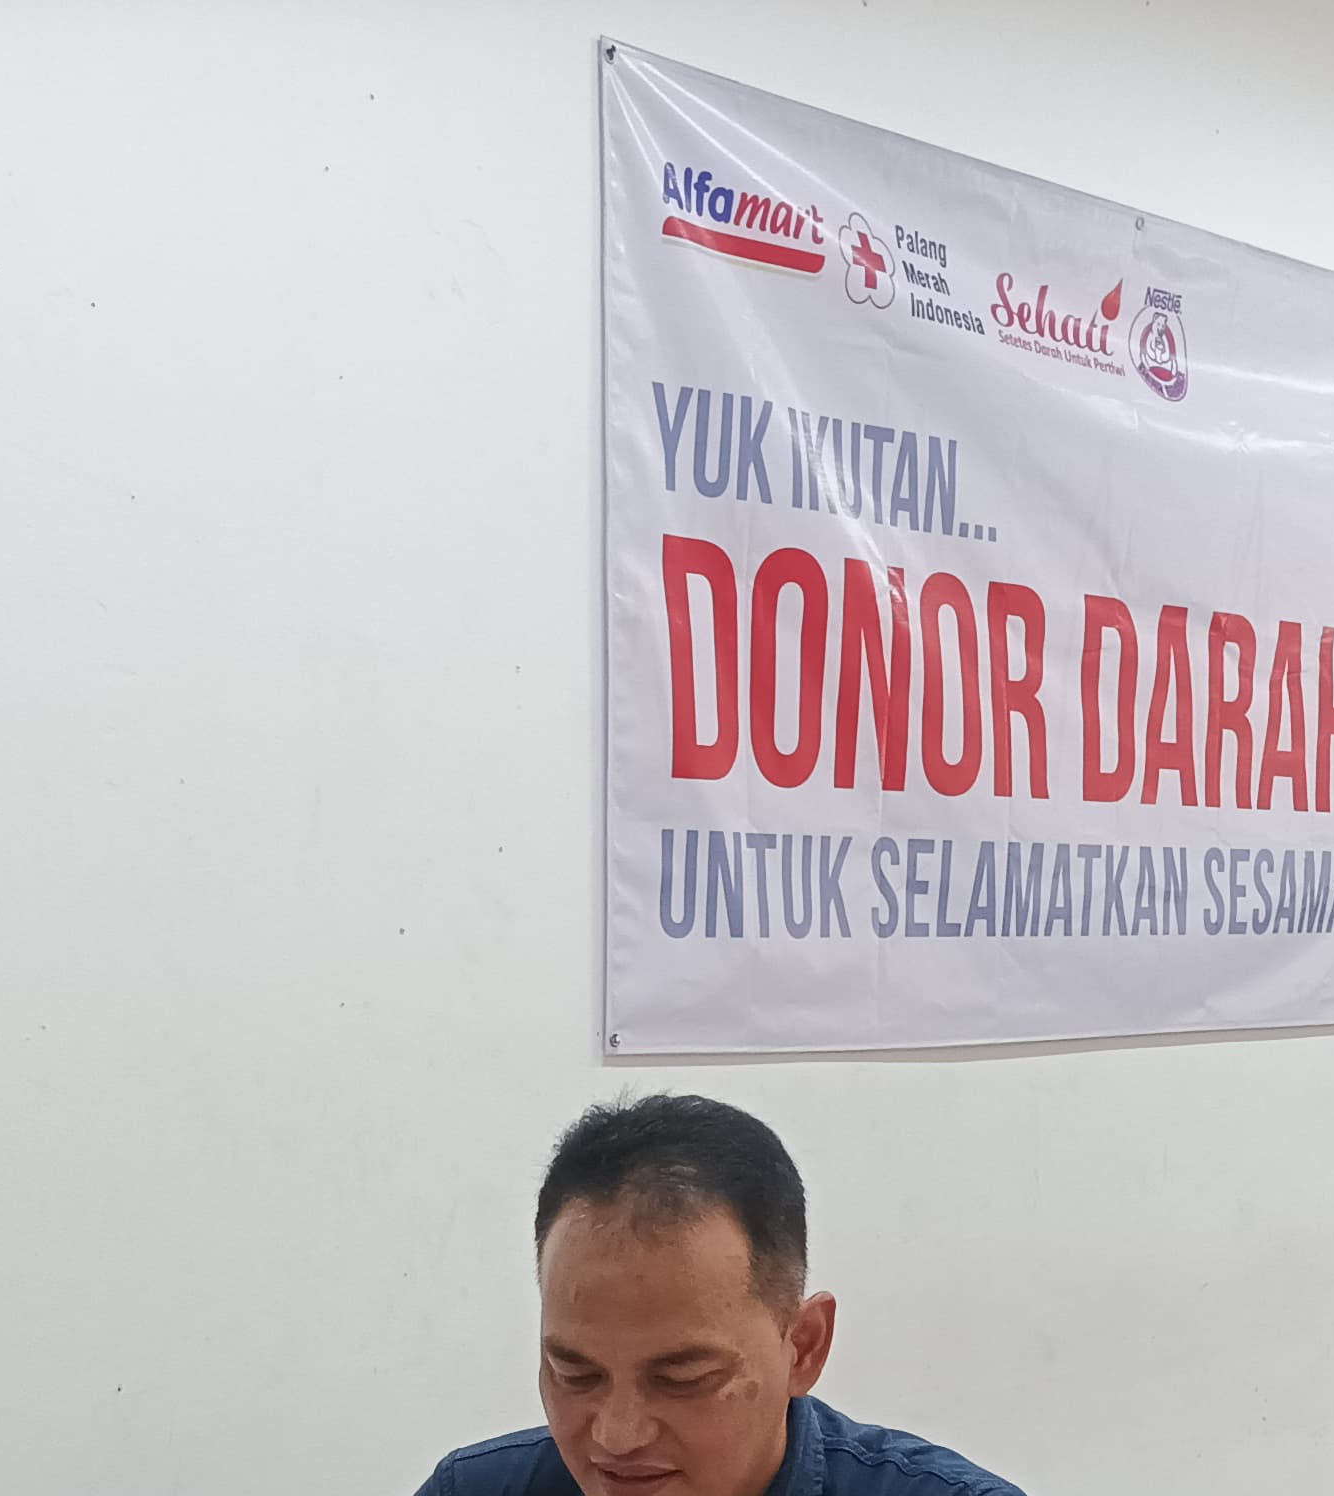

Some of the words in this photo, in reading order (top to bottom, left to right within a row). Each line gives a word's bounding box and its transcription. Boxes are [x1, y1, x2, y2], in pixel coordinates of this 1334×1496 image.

[662, 161, 825, 245] Alfamart
[895, 225, 948, 268] Palang
[901, 260, 951, 296] Merah
[910, 292, 986, 335] Indonesia
[990, 272, 1124, 357] Sehati
[998, 329, 1033, 352] Setetes
[1033, 340, 1063, 361] Darah
[1063, 348, 1093, 370] Untuk
[1093, 357, 1126, 377] Pertiwi
[652, 381, 774, 505] YUK
[787, 406, 998, 543] IKUTAN...
[662, 533, 1050, 799] DONOR
[658, 828, 853, 940] UNTUK
[869, 836, 1189, 938] SELAMATKAN
